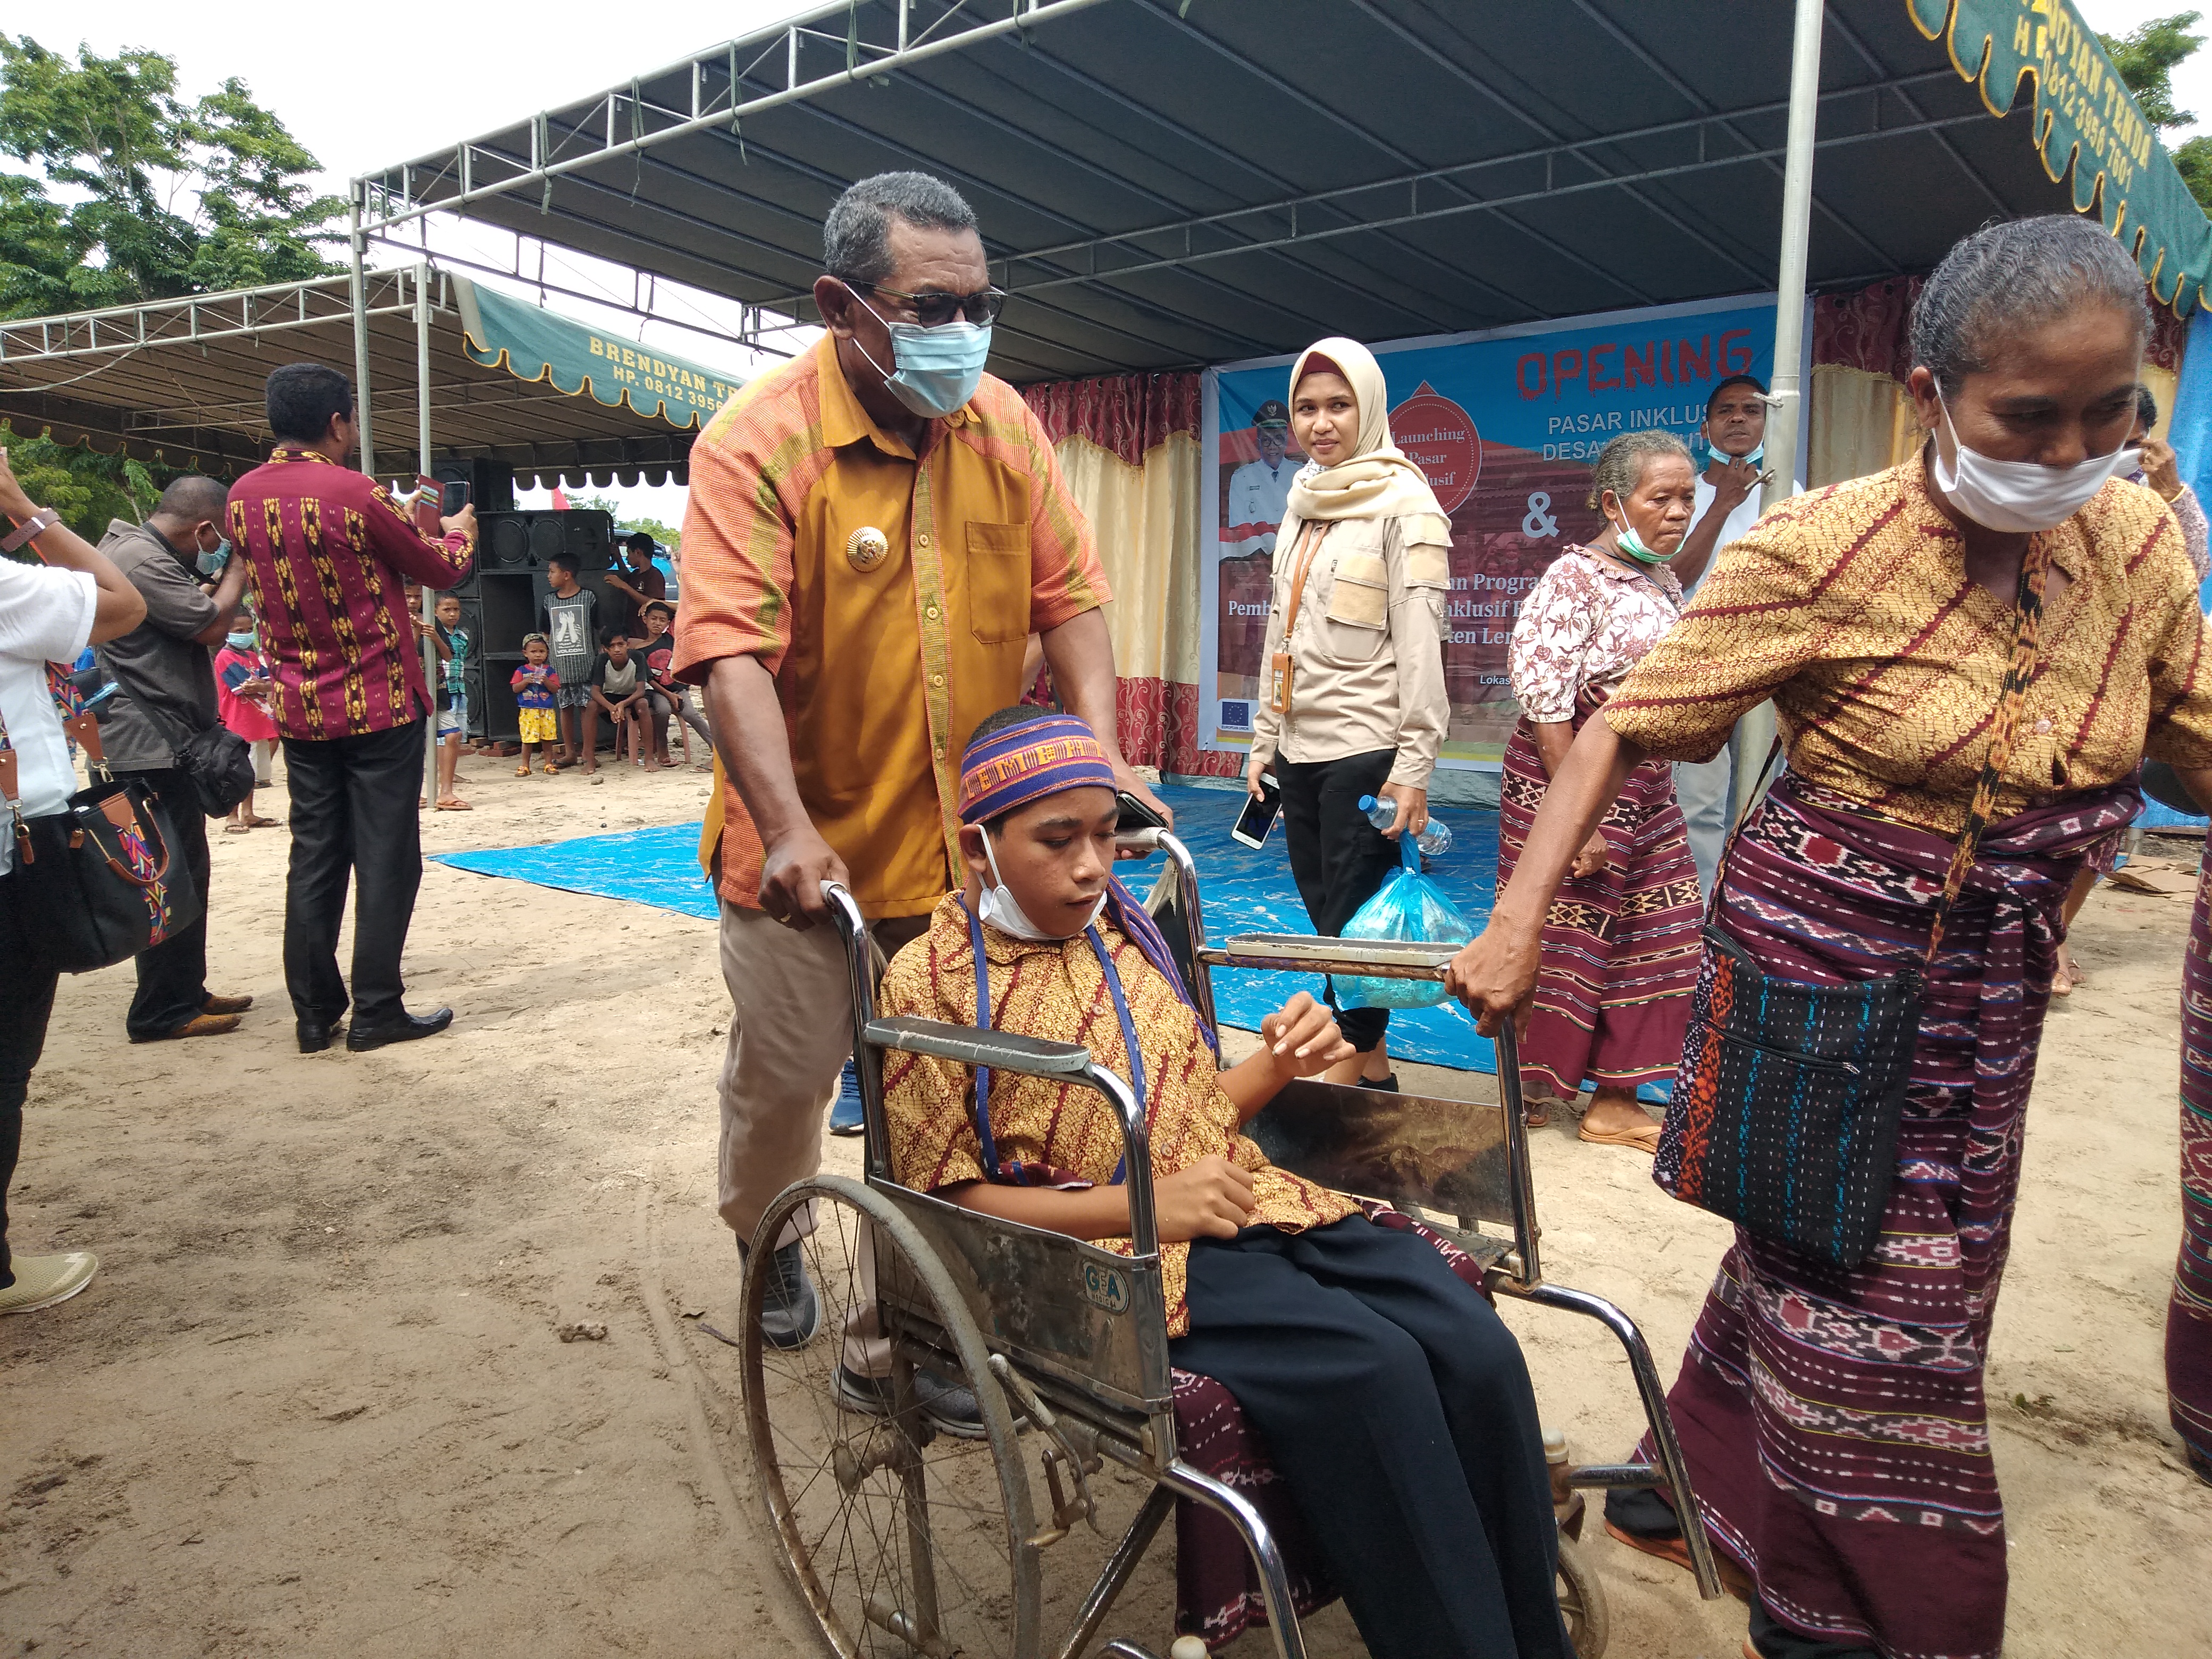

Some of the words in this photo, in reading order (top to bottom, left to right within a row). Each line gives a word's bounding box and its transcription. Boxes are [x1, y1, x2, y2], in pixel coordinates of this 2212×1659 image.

[2042, 49, 2076, 118] 0812
[2075, 96, 2106, 158] 3956
[2104, 77, 2151, 171] TENDA
[590, 336, 706, 392] BRENDYAN
[1516, 328, 1753, 403] OPENING
[613, 365, 640, 387] HP.
[645, 376, 684, 401] 0812
[688, 391, 723, 412] 3956
[1548, 410, 1623, 435] PASAR
[1390, 428, 1465, 444] Launching
[1409, 452, 1447, 465] Pasar
[1543, 440, 1601, 462] DESA
[1425, 471, 1456, 487] lusif
[1522, 491, 1560, 538] &
[1473, 573, 1541, 595] Progra
[1228, 600, 1271, 616] Pemb
[1480, 675, 1511, 685] Lokas
[1086, 1266, 1121, 1301] GEA
